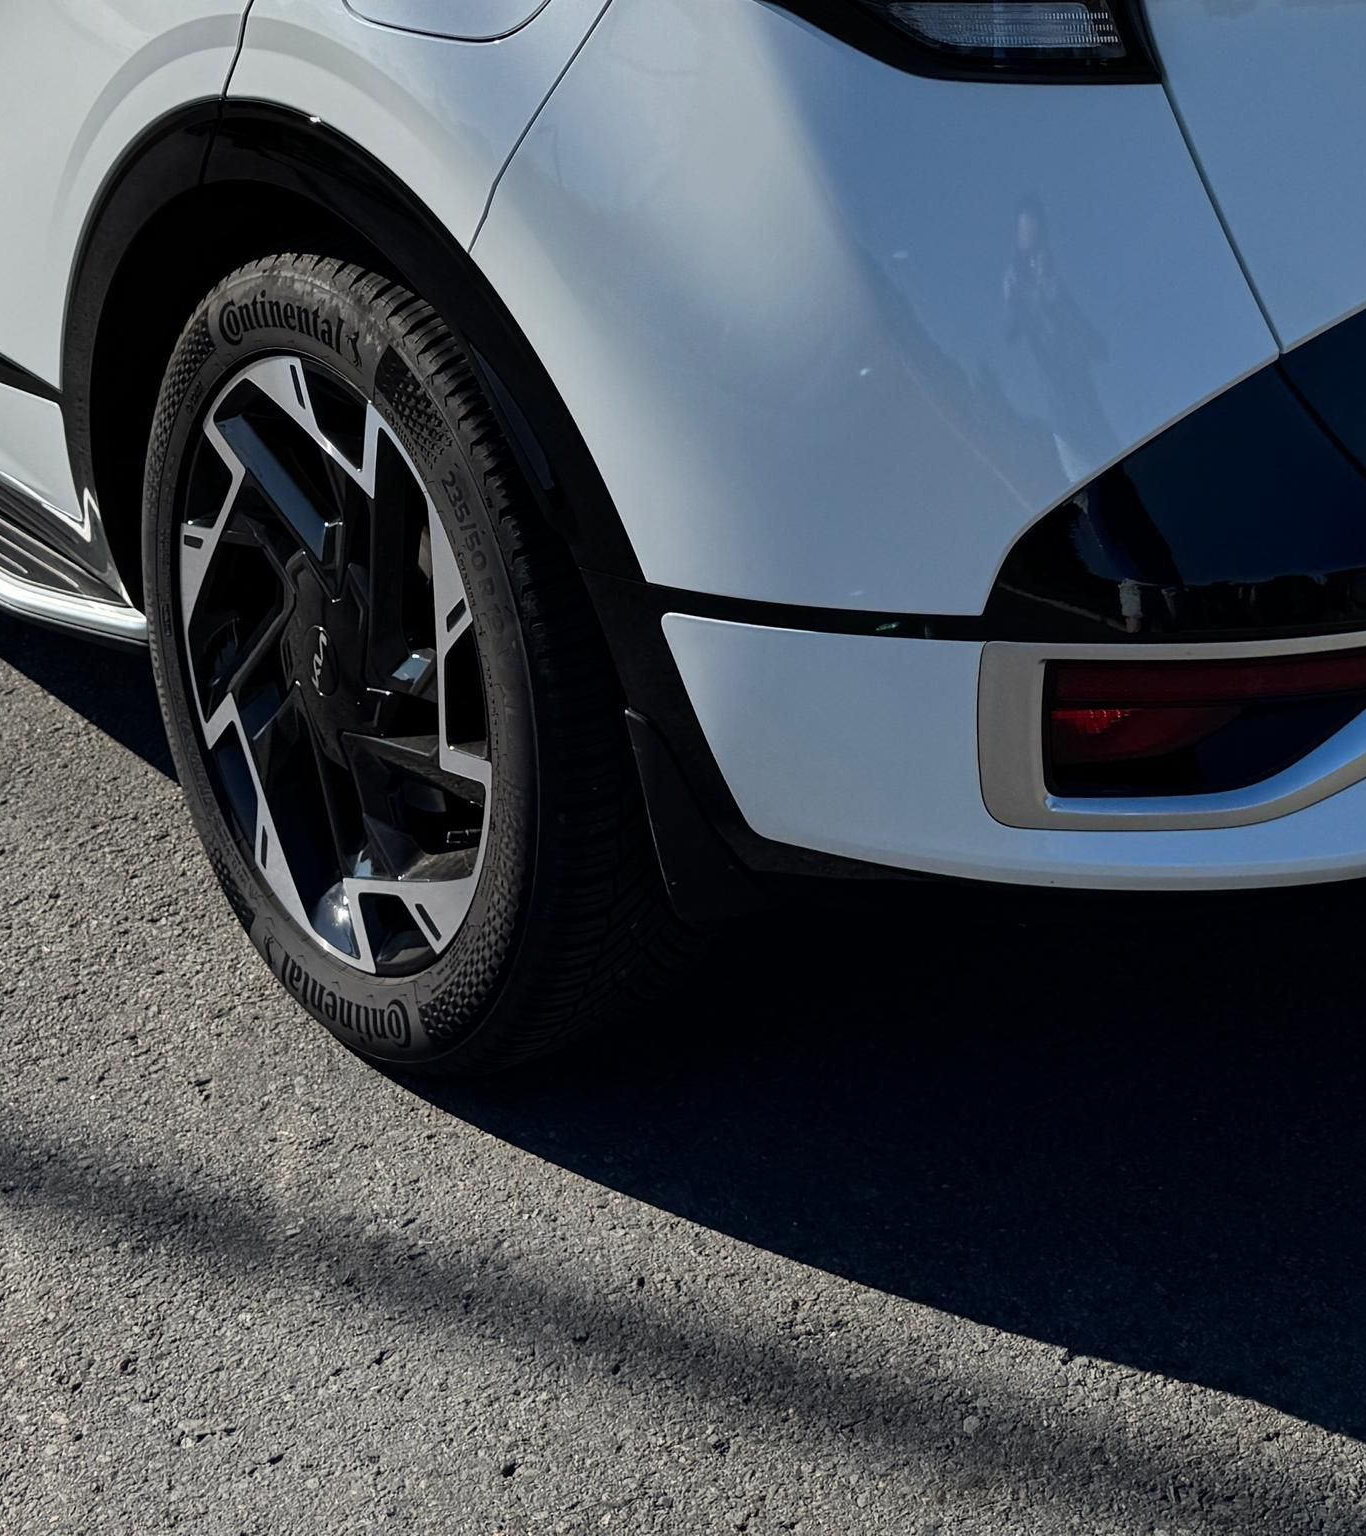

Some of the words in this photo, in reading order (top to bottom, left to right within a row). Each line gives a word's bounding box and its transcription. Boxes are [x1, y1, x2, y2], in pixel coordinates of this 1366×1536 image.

[218, 290, 345, 356] Continental
[441, 470, 487, 572] 235/50
[280, 951, 412, 1049] Continental
